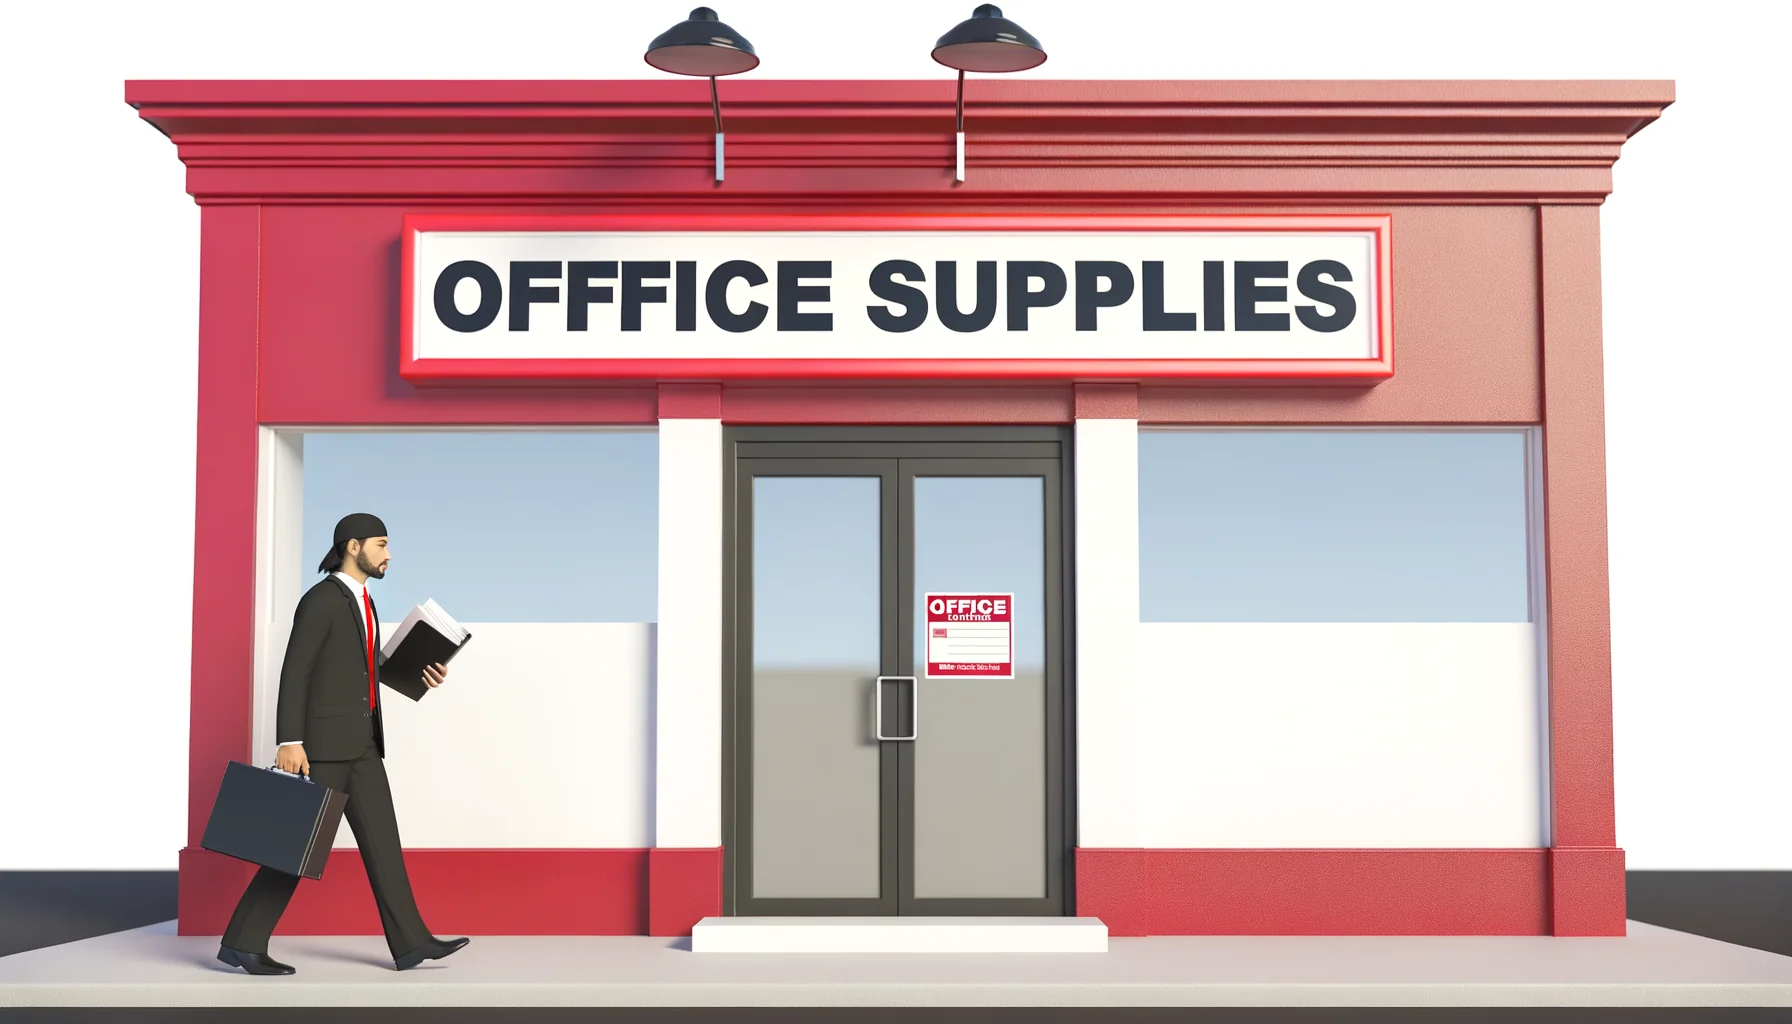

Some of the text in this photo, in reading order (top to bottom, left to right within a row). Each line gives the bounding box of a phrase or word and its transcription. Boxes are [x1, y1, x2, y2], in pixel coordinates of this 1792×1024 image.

[434, 260, 1356, 332] OFFFICE SUPPLIES
[929, 598, 1006, 615] OFFICE
